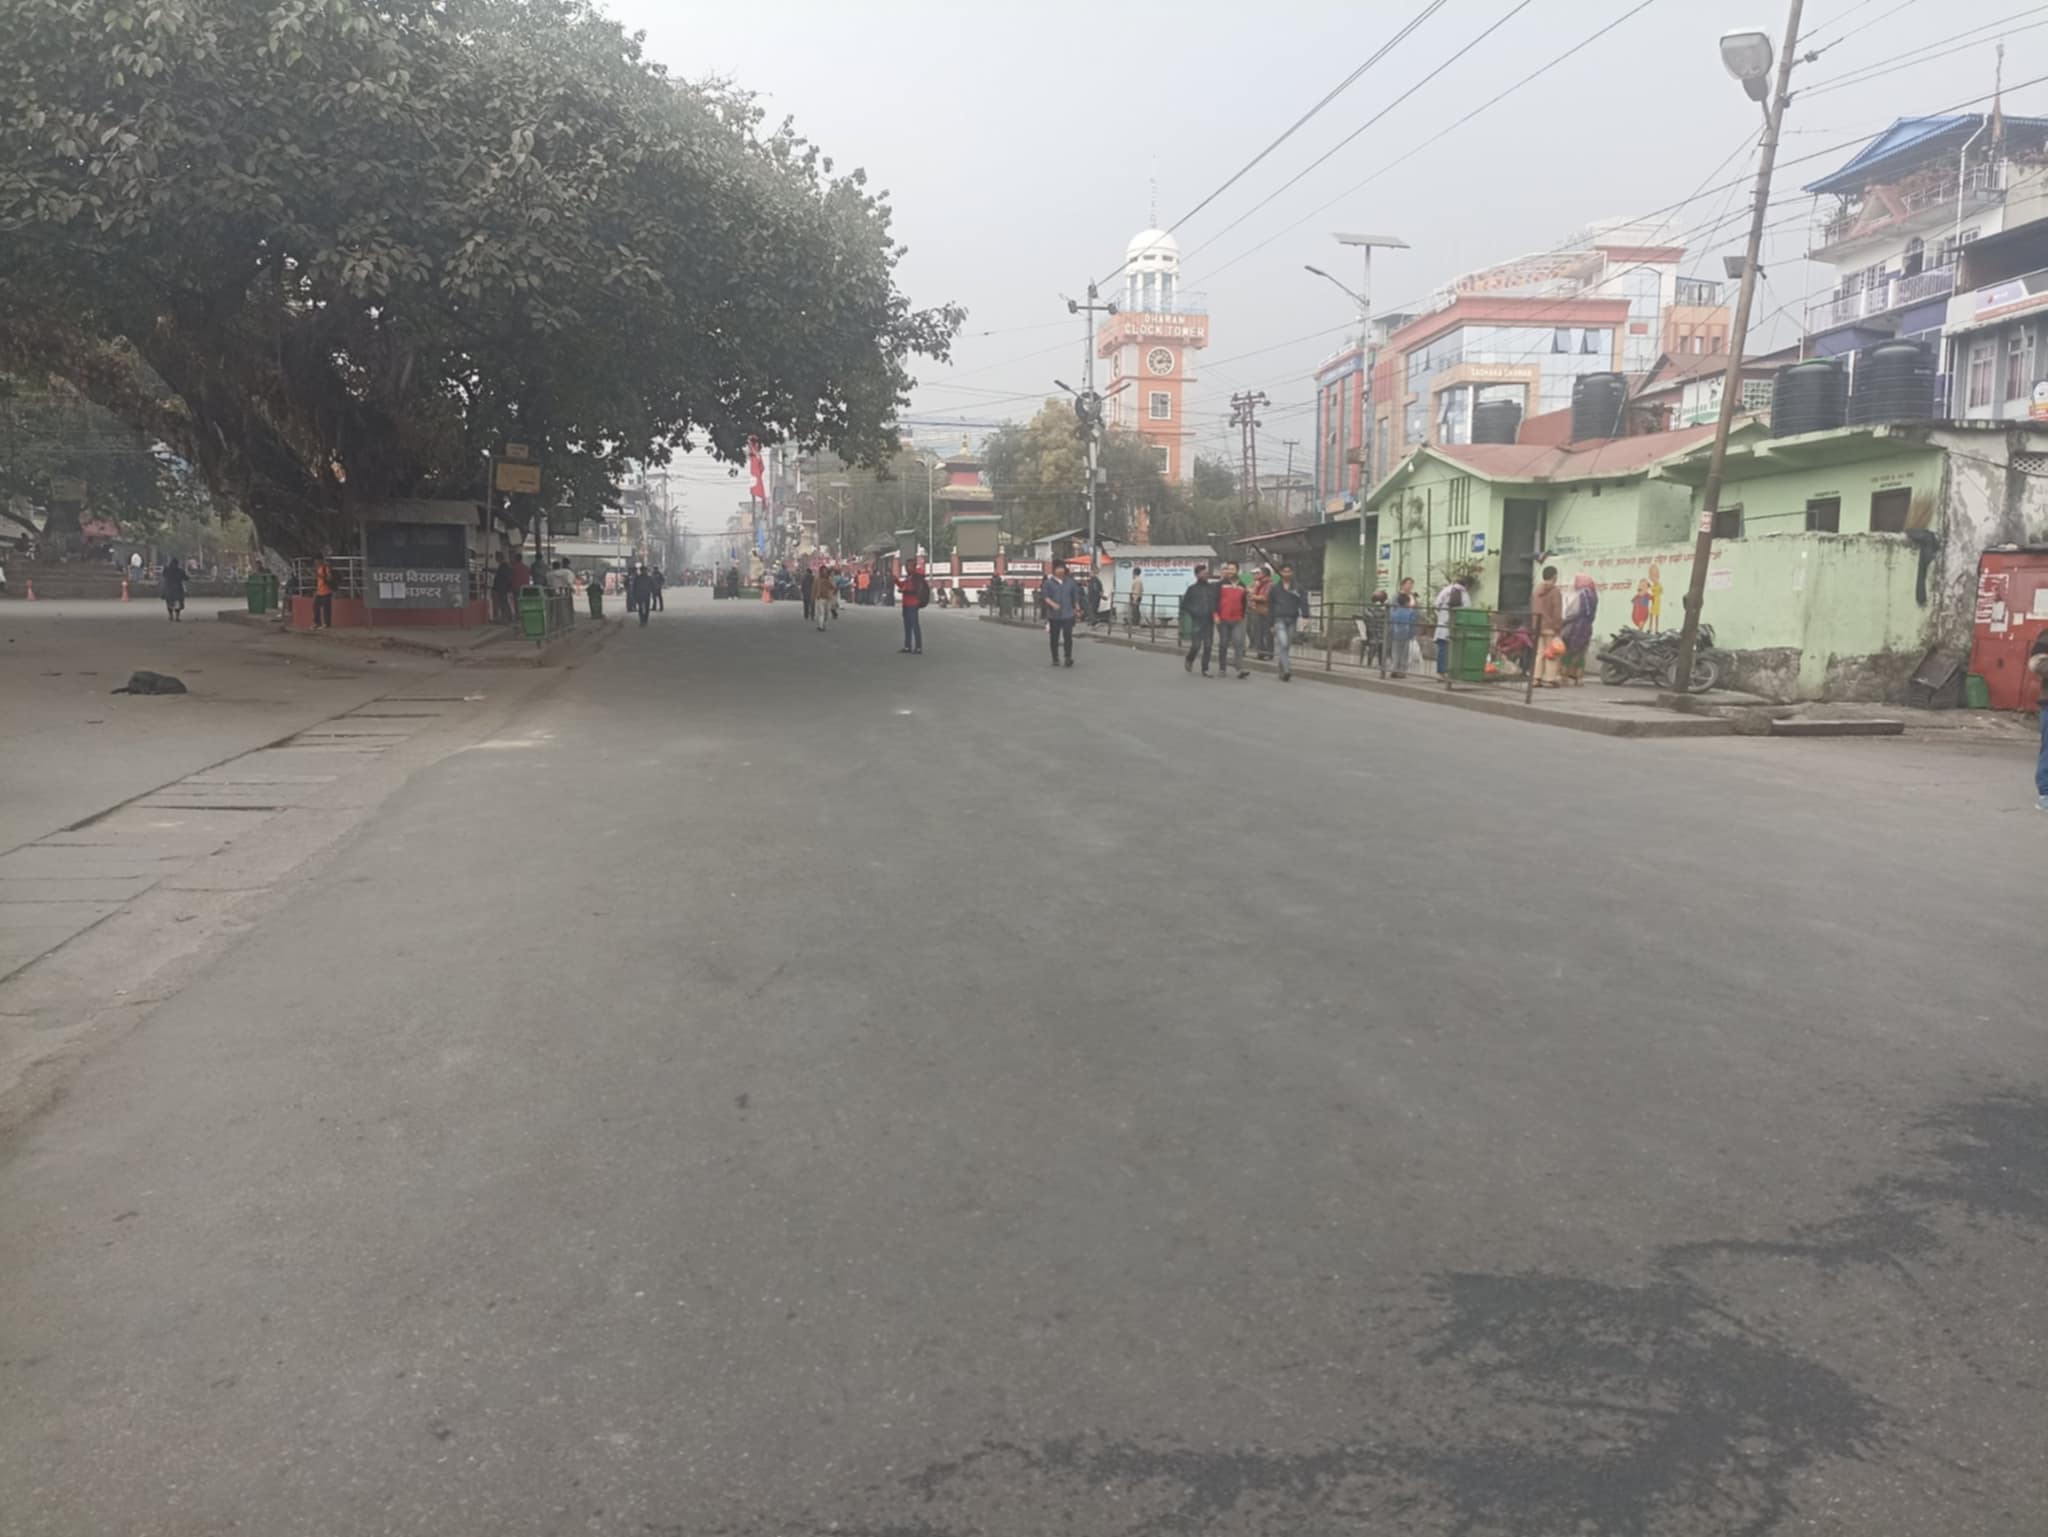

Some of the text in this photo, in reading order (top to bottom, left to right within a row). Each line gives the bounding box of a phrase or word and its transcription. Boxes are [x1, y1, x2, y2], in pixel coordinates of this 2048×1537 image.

[1144, 313, 1185, 325] DHARAN
[1123, 323, 1205, 337] CLOCK TOWER
[373, 569, 462, 583] धरान विराटनगर
